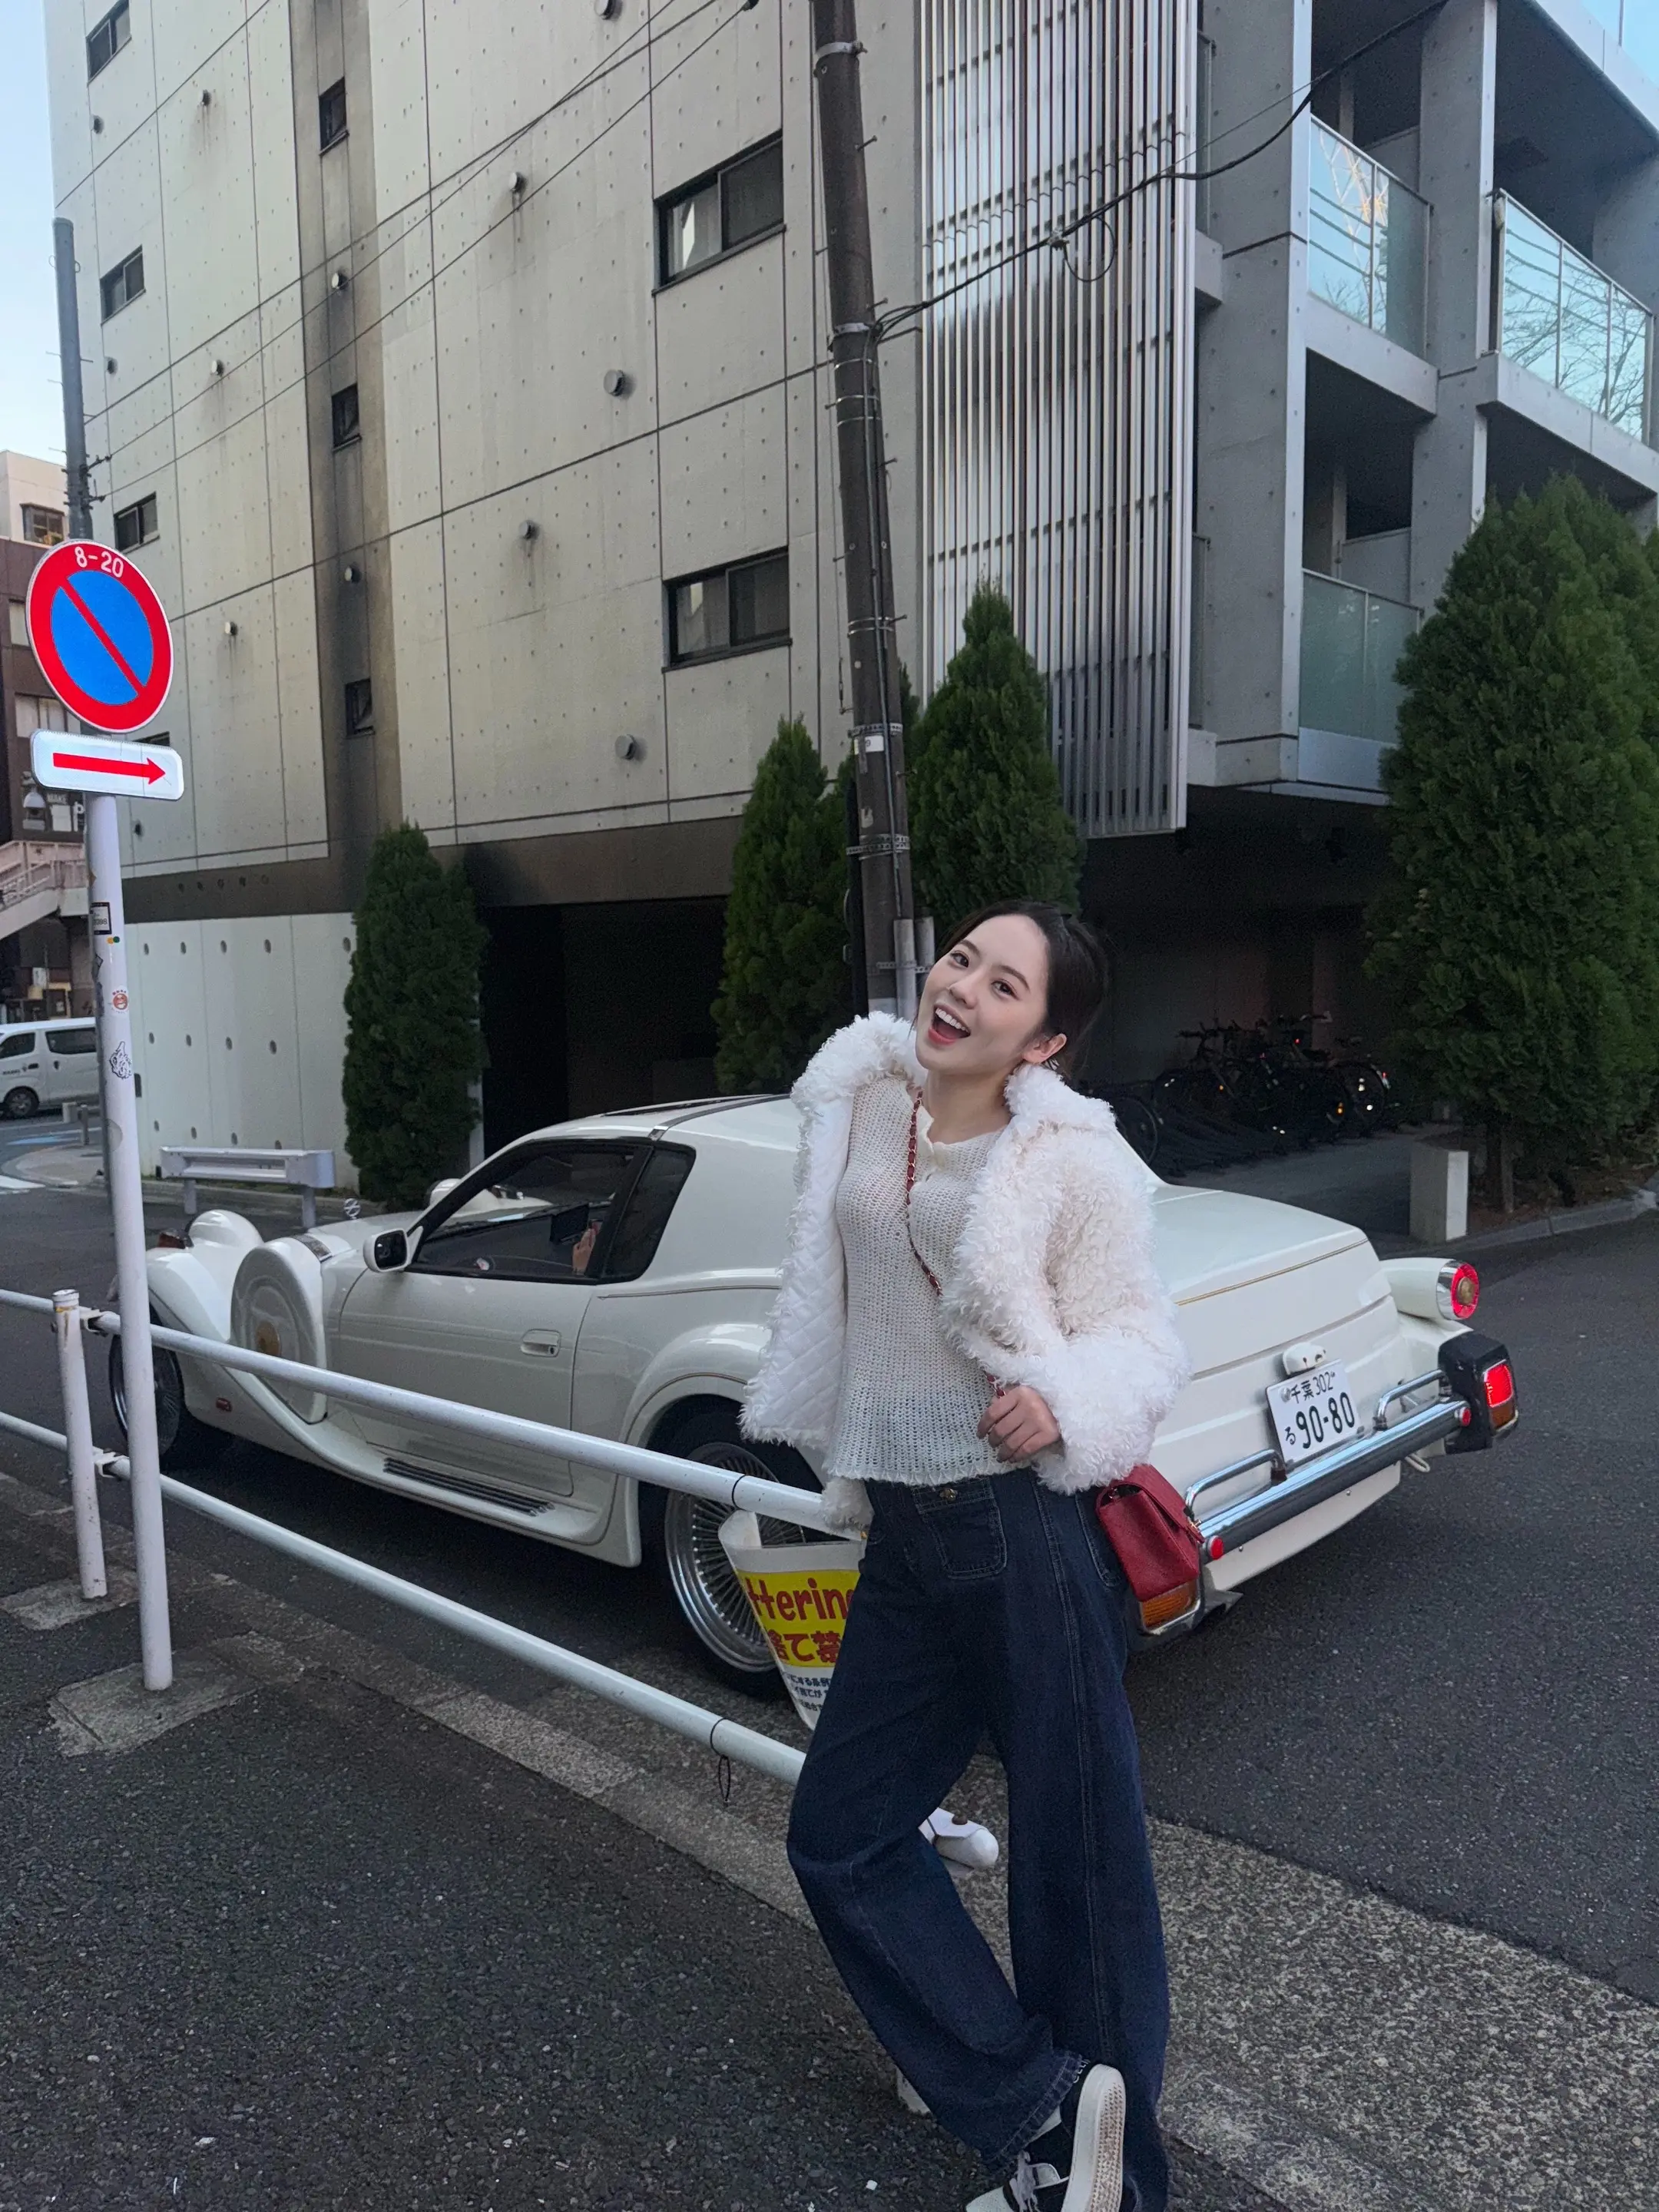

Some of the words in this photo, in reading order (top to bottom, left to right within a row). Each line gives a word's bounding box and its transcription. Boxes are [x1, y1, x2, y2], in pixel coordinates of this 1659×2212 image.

[75, 546, 124, 578] 8-20
[1290, 1380, 1314, 1404] 千葉
[1313, 1371, 1333, 1396] 302
[1284, 1426, 1296, 1445] る
[1296, 1392, 1355, 1449] 90-80
[745, 1578, 854, 1621] tterin
